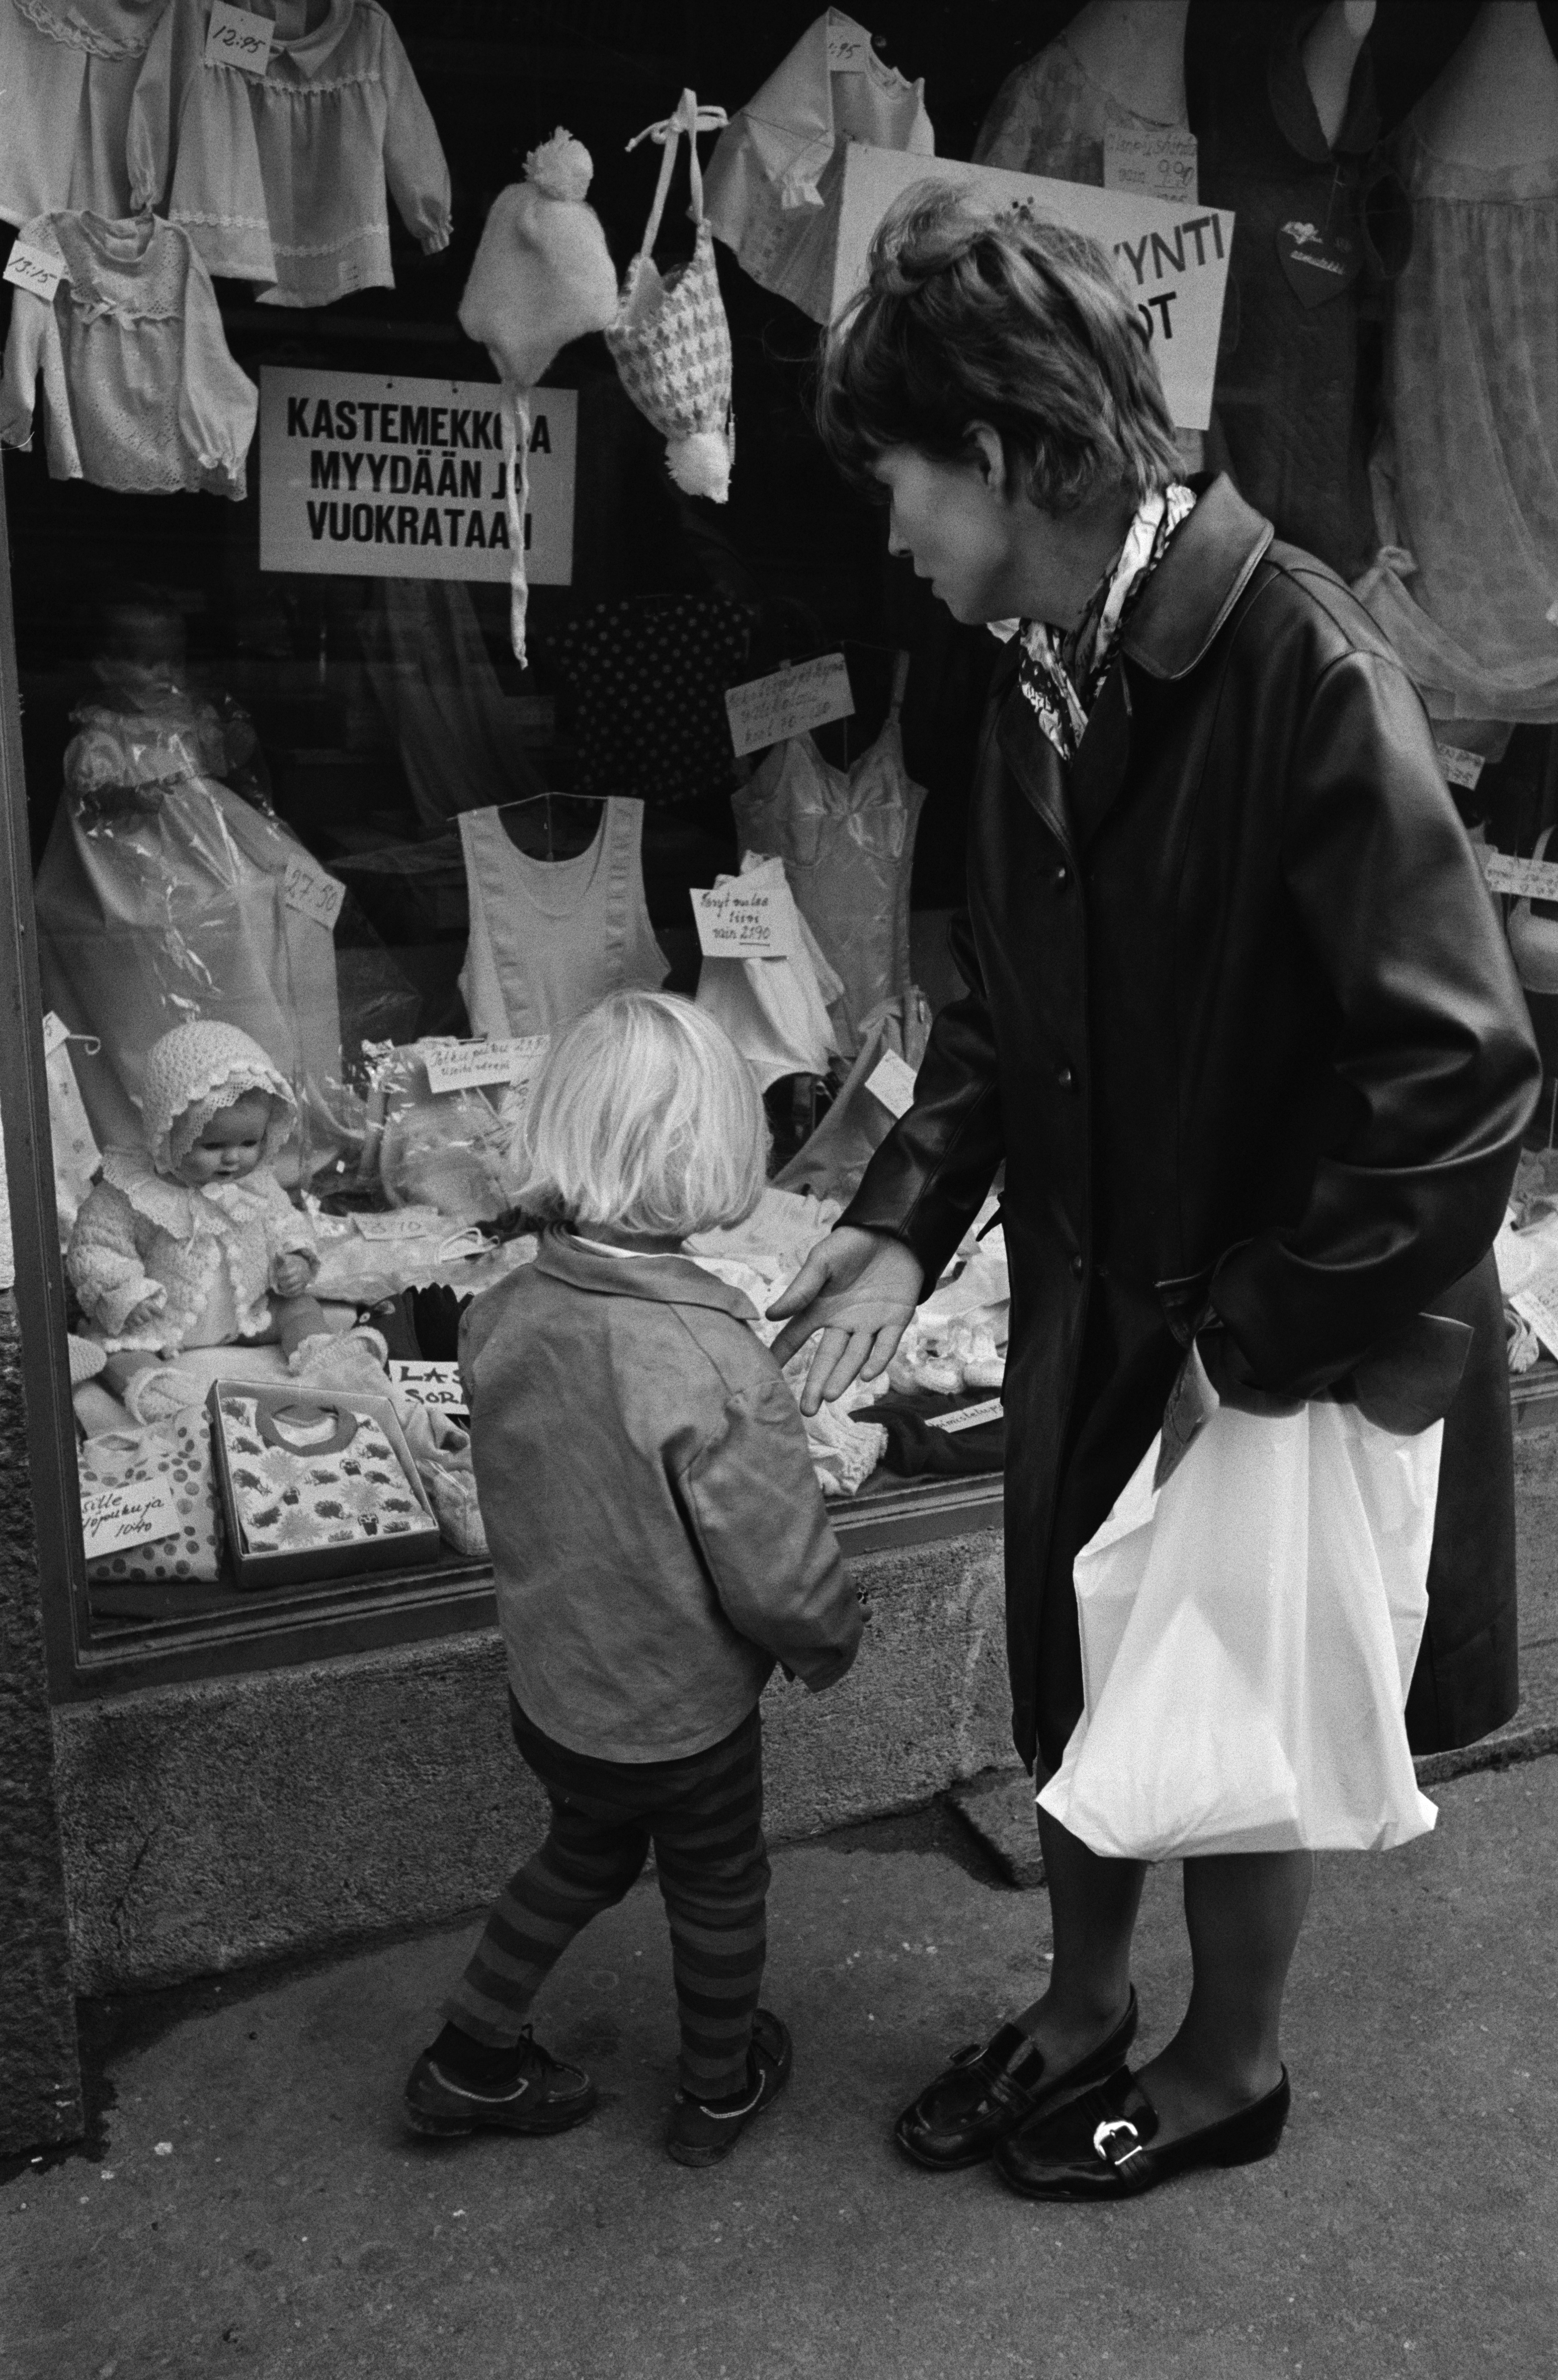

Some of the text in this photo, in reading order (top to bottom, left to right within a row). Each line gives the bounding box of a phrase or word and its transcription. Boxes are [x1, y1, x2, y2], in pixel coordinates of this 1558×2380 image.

[828, 42, 861, 59] :95
[1113, 213, 1224, 285] YNTI
[287, 397, 552, 454] KASTEMEKKA
[311, 448, 481, 499] MYYDÄÄN
